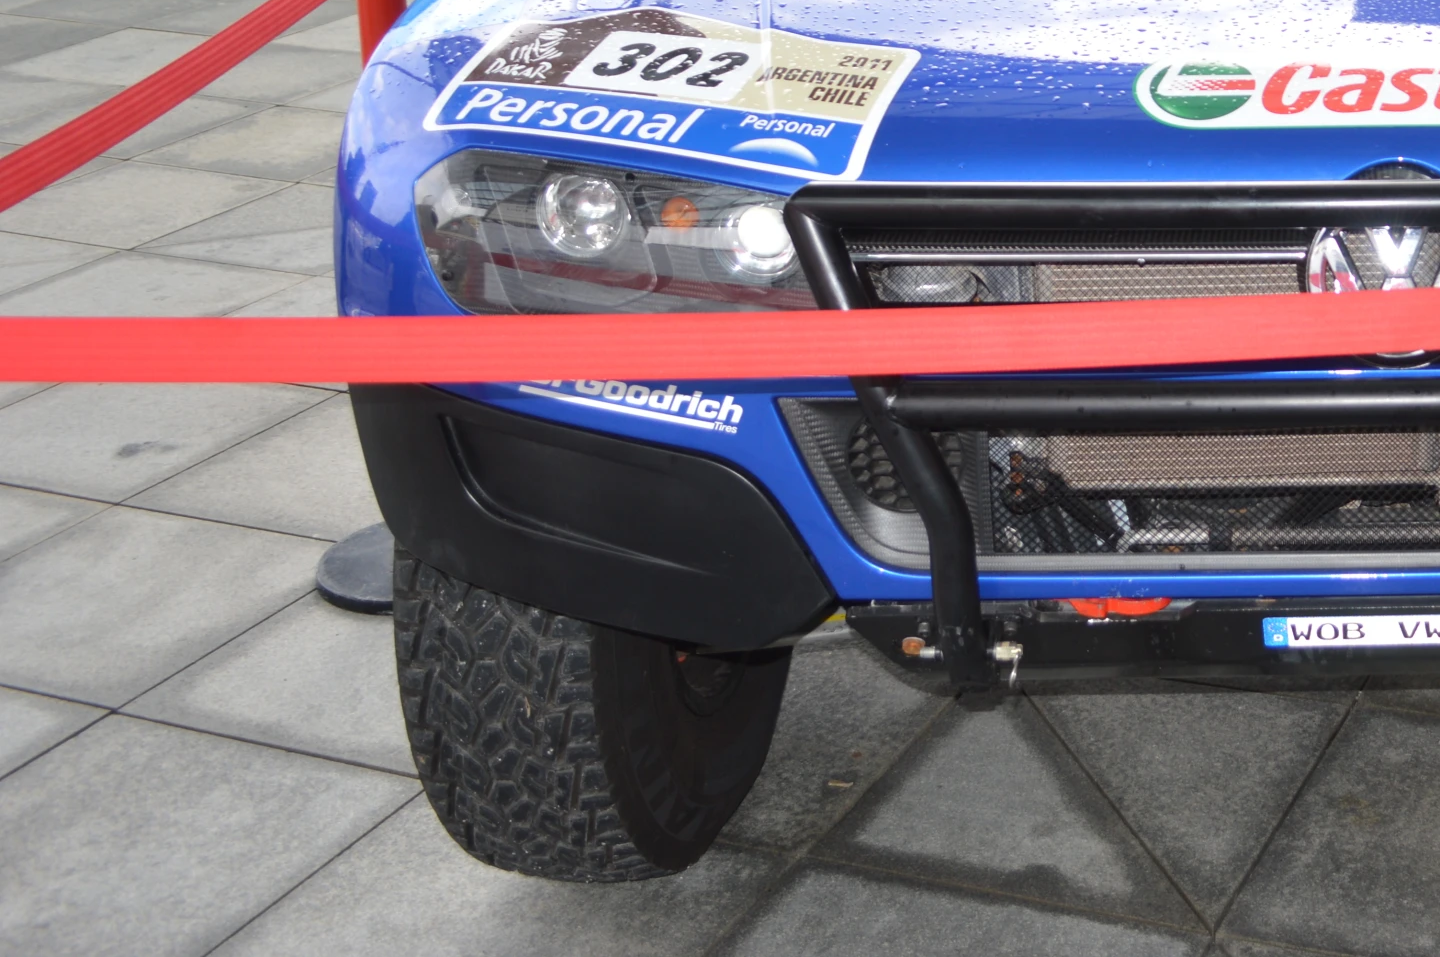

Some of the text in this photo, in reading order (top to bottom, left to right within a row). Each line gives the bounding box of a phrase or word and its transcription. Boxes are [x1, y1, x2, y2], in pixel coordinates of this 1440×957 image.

[485, 57, 553, 80] DAKAR
[592, 42, 751, 88] 302
[838, 55, 893, 71] 2011
[756, 66, 879, 90] ARGENTINA
[808, 86, 871, 107] CHILE
[456, 87, 704, 144] Personal
[740, 114, 835, 138] Personal
[713, 421, 738, 434] Tires
[1291, 623, 1366, 640] WOB
